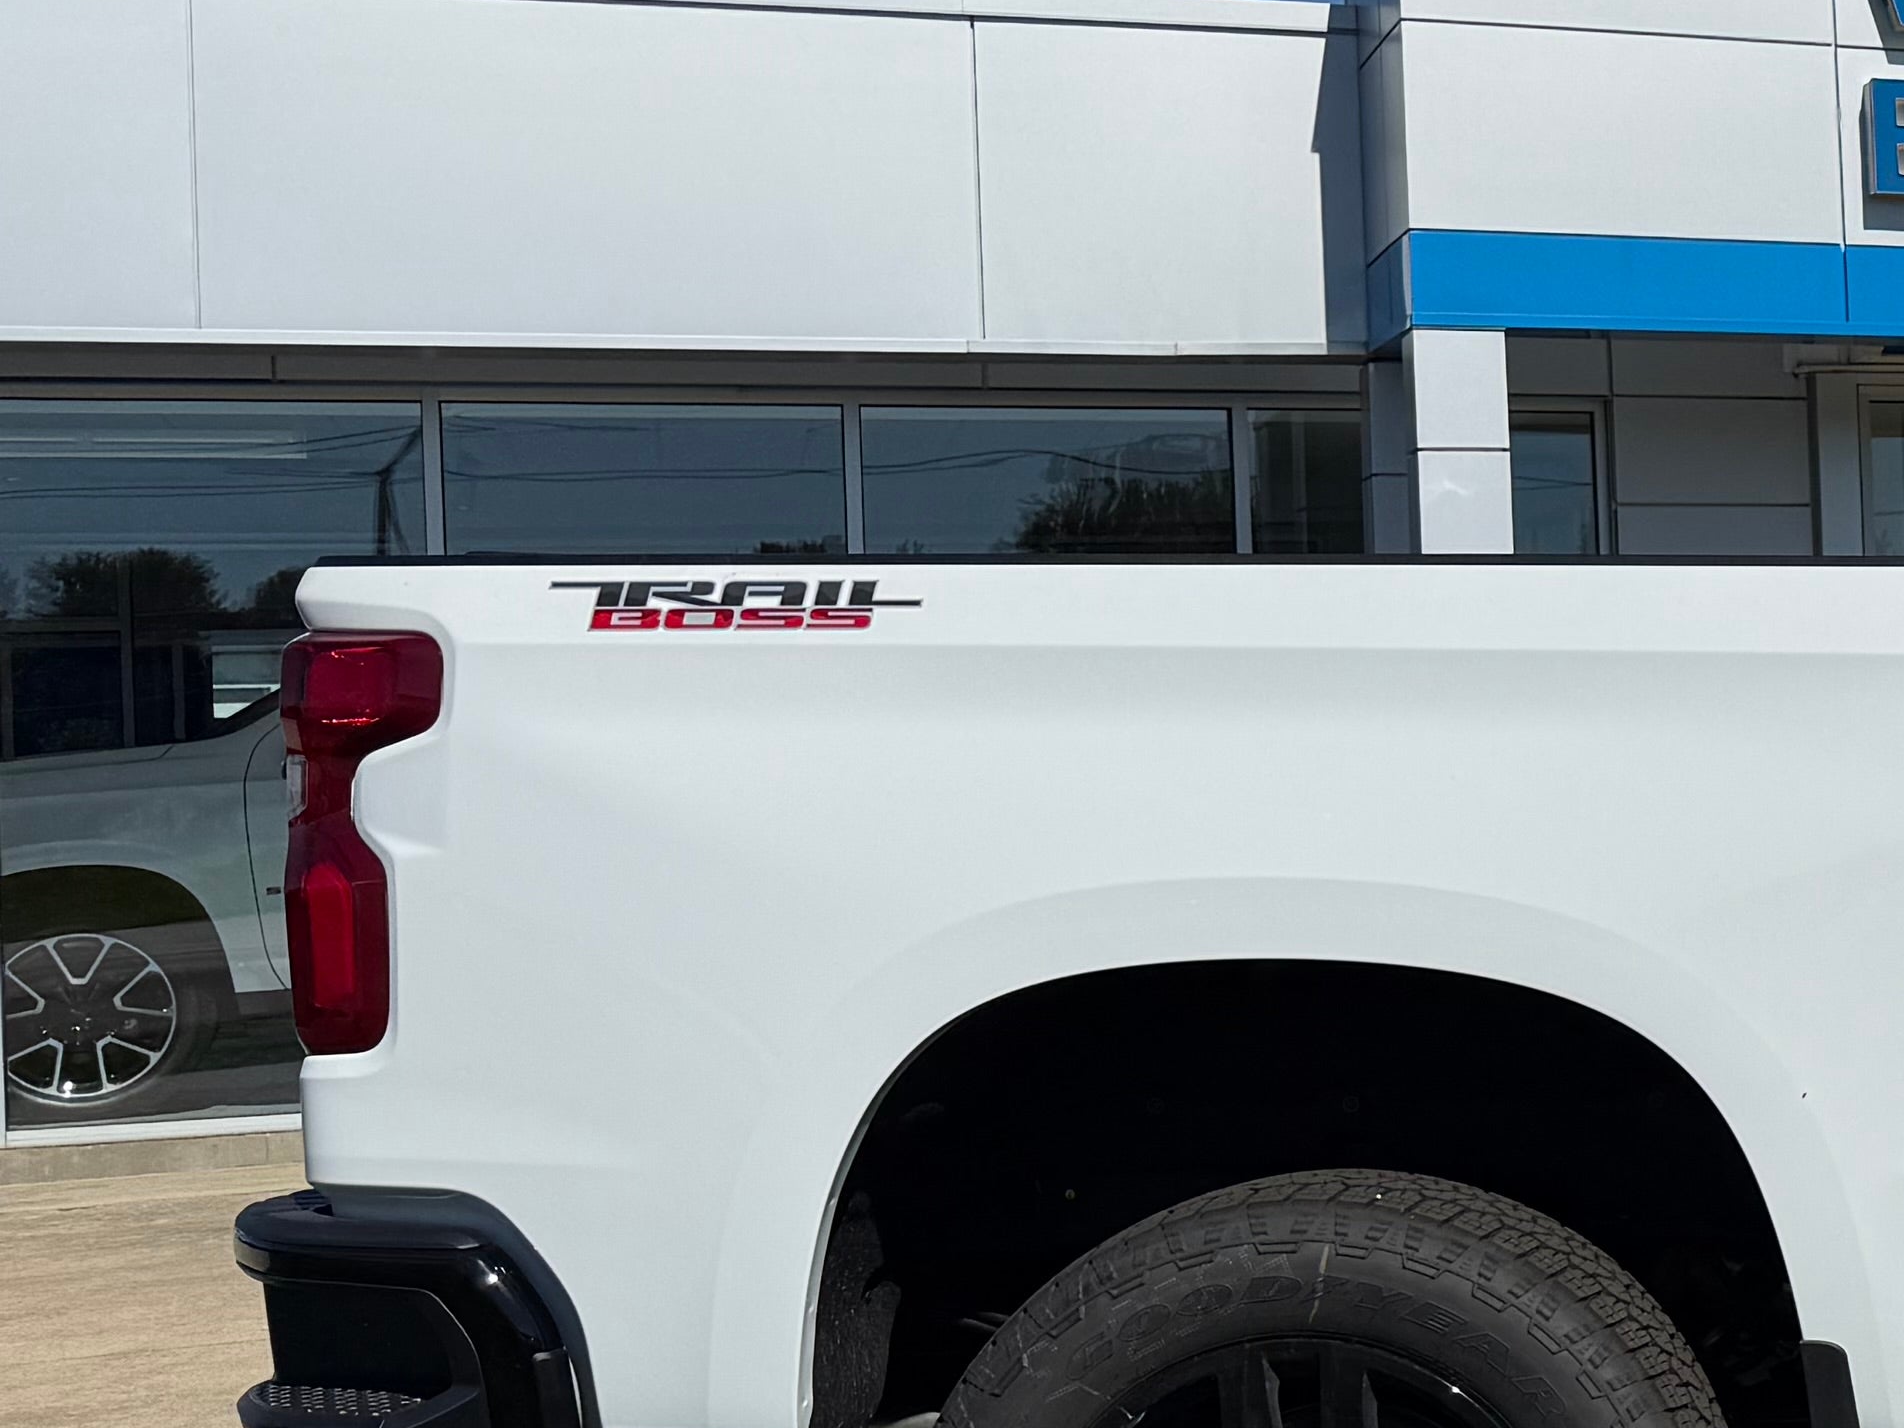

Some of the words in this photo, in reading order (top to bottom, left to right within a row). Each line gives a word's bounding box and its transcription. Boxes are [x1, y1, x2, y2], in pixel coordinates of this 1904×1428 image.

[549, 579, 924, 608] TRAIL
[587, 606, 874, 632] BOSS
[1065, 1274, 1568, 1420] GOODYEAR
